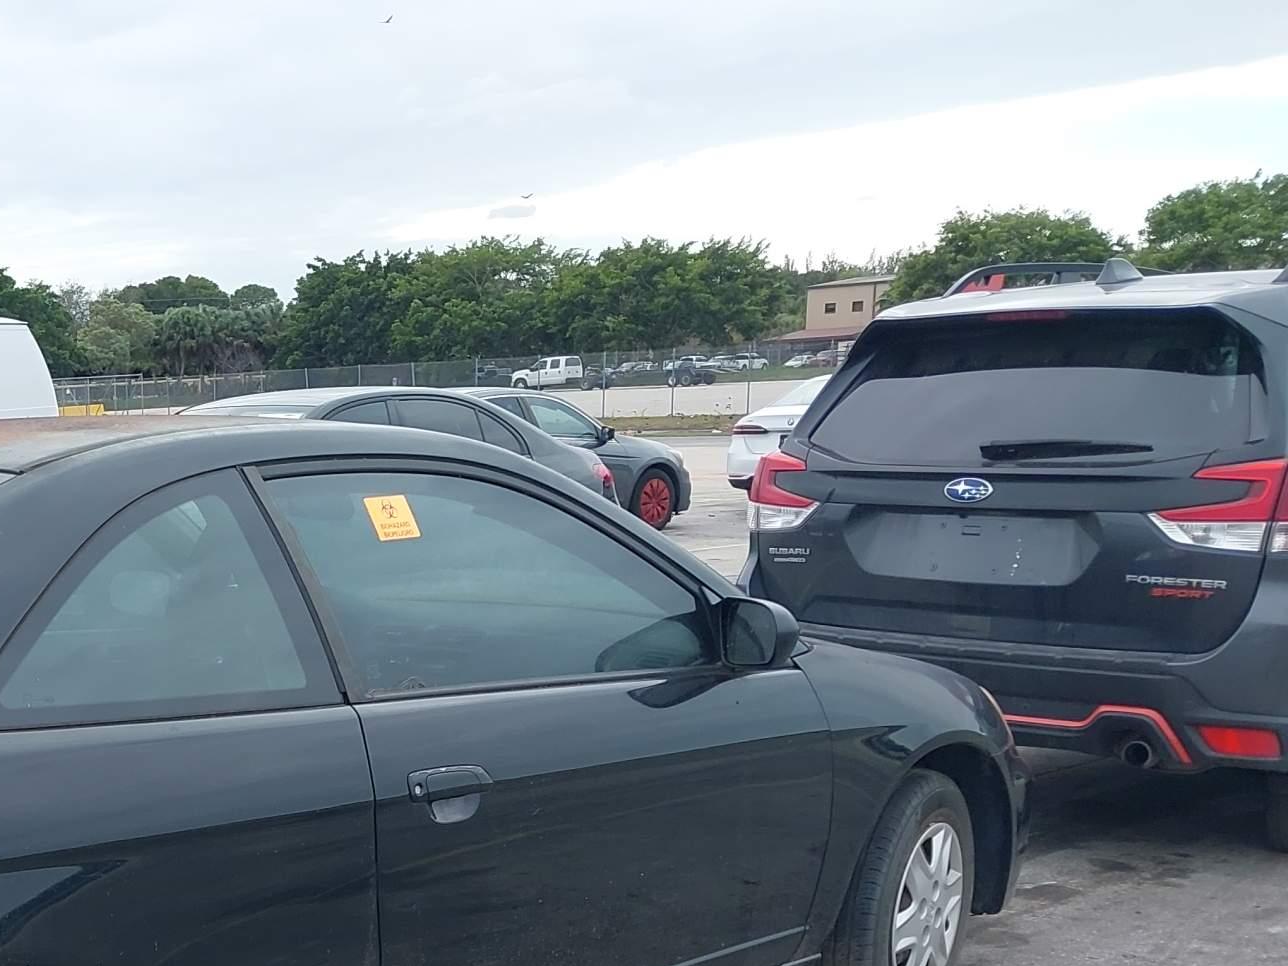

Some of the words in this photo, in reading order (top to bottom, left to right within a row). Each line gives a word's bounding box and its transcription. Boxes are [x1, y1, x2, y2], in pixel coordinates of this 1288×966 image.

[769, 547, 810, 555] SUBARU
[1125, 574, 1228, 589] FORESTER
[1151, 587, 1214, 598] SPORT
